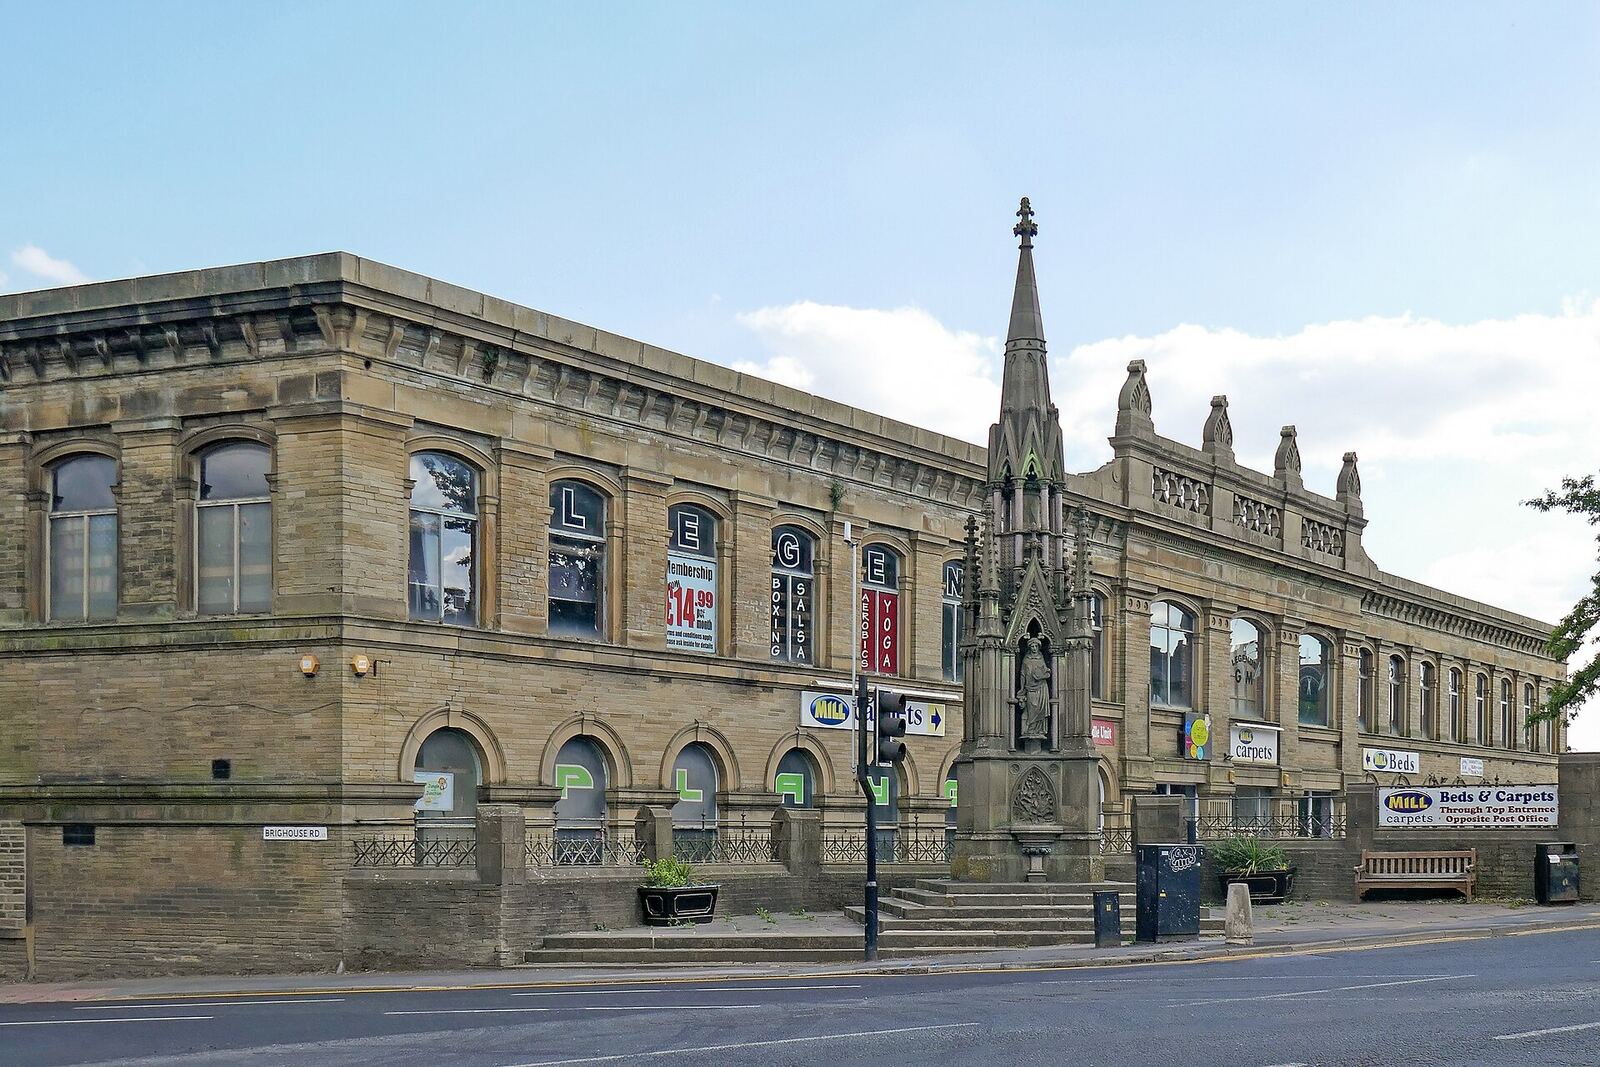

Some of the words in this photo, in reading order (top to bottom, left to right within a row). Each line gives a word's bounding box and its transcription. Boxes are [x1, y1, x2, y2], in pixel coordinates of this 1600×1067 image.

[562, 487, 586, 529] L
[677, 511, 700, 550] E
[777, 533, 800, 568] G
[867, 550, 885, 584] E
[668, 580, 680, 590] rom
[696, 620, 713, 631] month
[771, 577, 781, 656] BOXING
[796, 582, 806, 659] SALSA
[683, 632, 702, 640] conditions
[702, 634, 713, 642] apply
[861, 593, 870, 668] AEROBICS
[883, 599, 892, 668] YOGA
[814, 699, 846, 720] MILL
[1236, 745, 1273, 762] carpets
[1389, 753, 1415, 771] Beds
[555, 764, 594, 799] P
[676, 768, 703, 802] L
[1388, 795, 1428, 809] MILL
[1440, 791, 1474, 803] Beds
[1479, 790, 1492, 803] &
[1495, 790, 1554, 804] Carpets
[1386, 814, 1434, 825] carpets
[1440, 806, 1483, 815] Through
[1485, 806, 1505, 815] Top
[1508, 806, 1556, 814] Entrance
[1446, 815, 1491, 824] Opposite
[1493, 815, 1515, 823] Post
[1517, 815, 1549, 823] Office
[265, 829, 308, 838] BRIGHOUSE
[310, 829, 320, 838] RD
